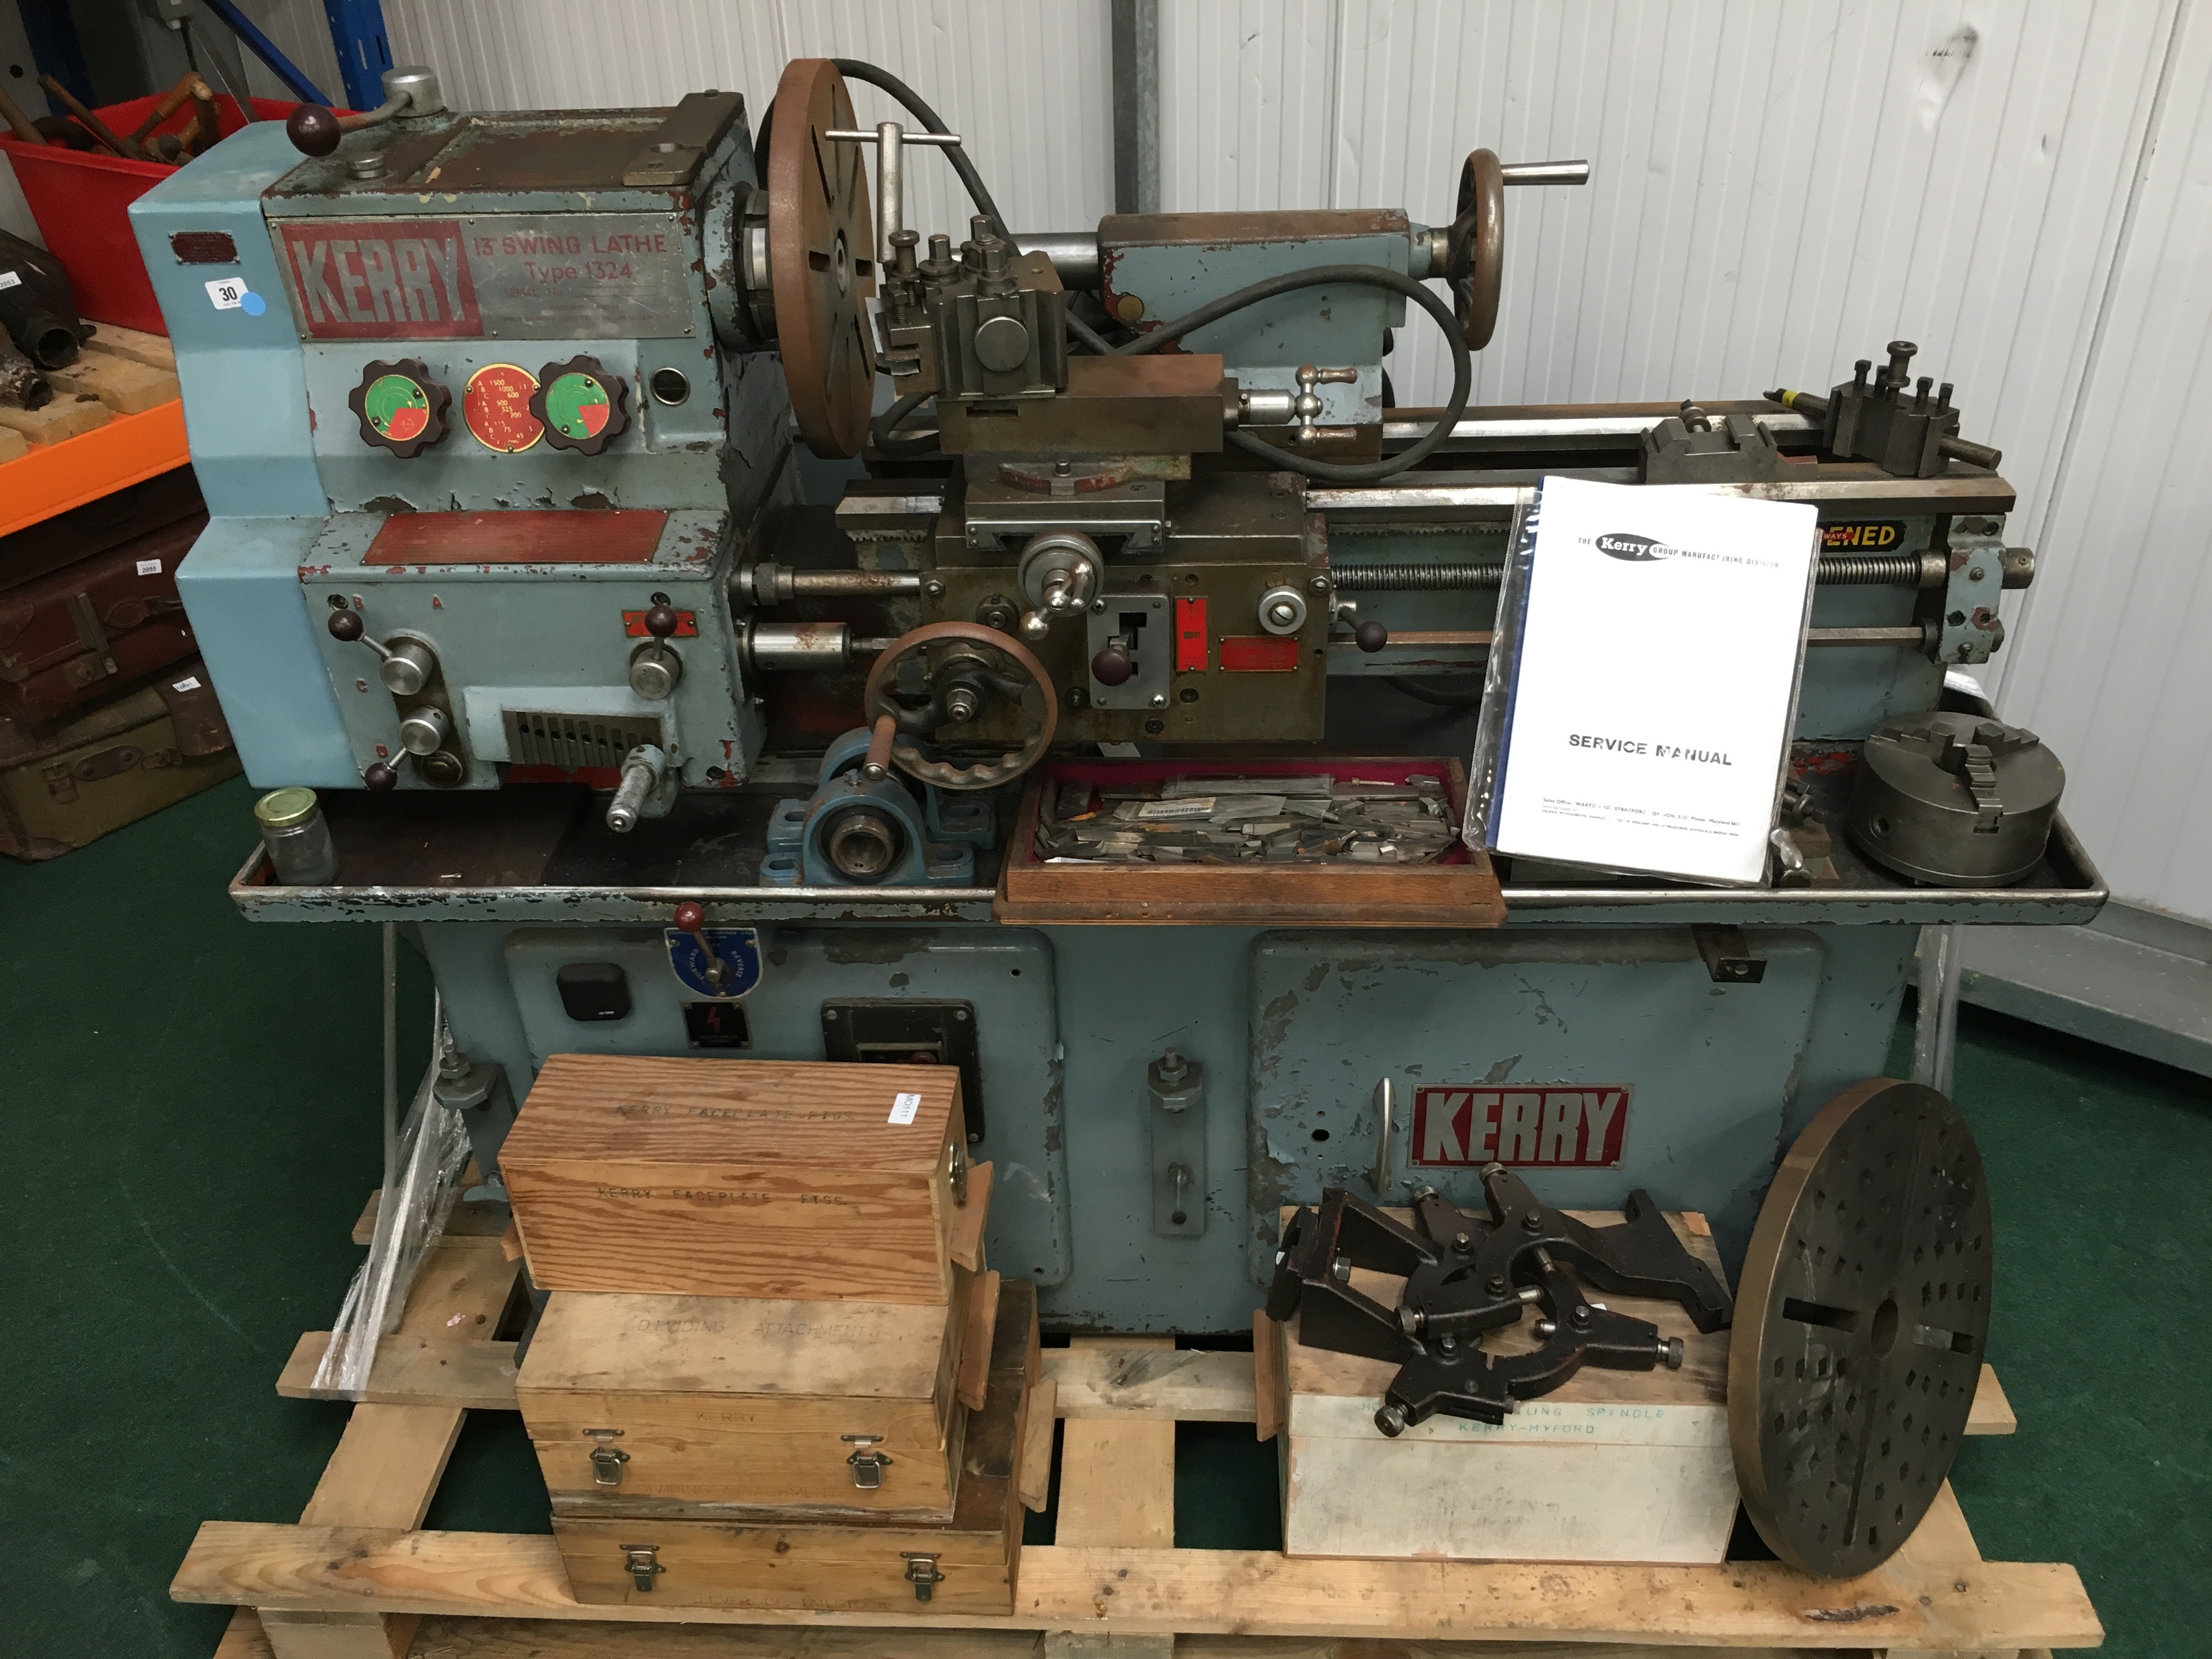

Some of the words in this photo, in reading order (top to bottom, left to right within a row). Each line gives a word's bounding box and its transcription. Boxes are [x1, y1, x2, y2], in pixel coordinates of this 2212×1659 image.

[502, 235, 580, 255] SWING
[591, 234, 668, 254] LATHE
[292, 236, 467, 323] KERRY
[523, 261, 578, 283] Type
[584, 261, 633, 279] 1324
[219, 286, 238, 302] 30
[1822, 532, 1848, 540] WAYS
[1601, 537, 1648, 556] Kerry
[1652, 546, 1679, 556] GROUP
[1746, 558, 1779, 568] DIVISION
[1568, 733, 1647, 755] SERVICE
[1655, 744, 1732, 766] MANUAL
[689, 948, 706, 981] FORWARD
[731, 950, 744, 979] REVERSE
[616, 1104, 670, 1116] KERRY
[687, 1107, 793, 1120] FACEPLATE
[1423, 1092, 1622, 1161] KERRY
[597, 1187, 652, 1199] KERRY
[672, 1189, 772, 1203] FACEPLATE
[696, 1411, 755, 1423] KERRY
[1586, 1407, 1665, 1419] SPINDLE
[1459, 1423, 1595, 1435] KERRY-MYFORD
